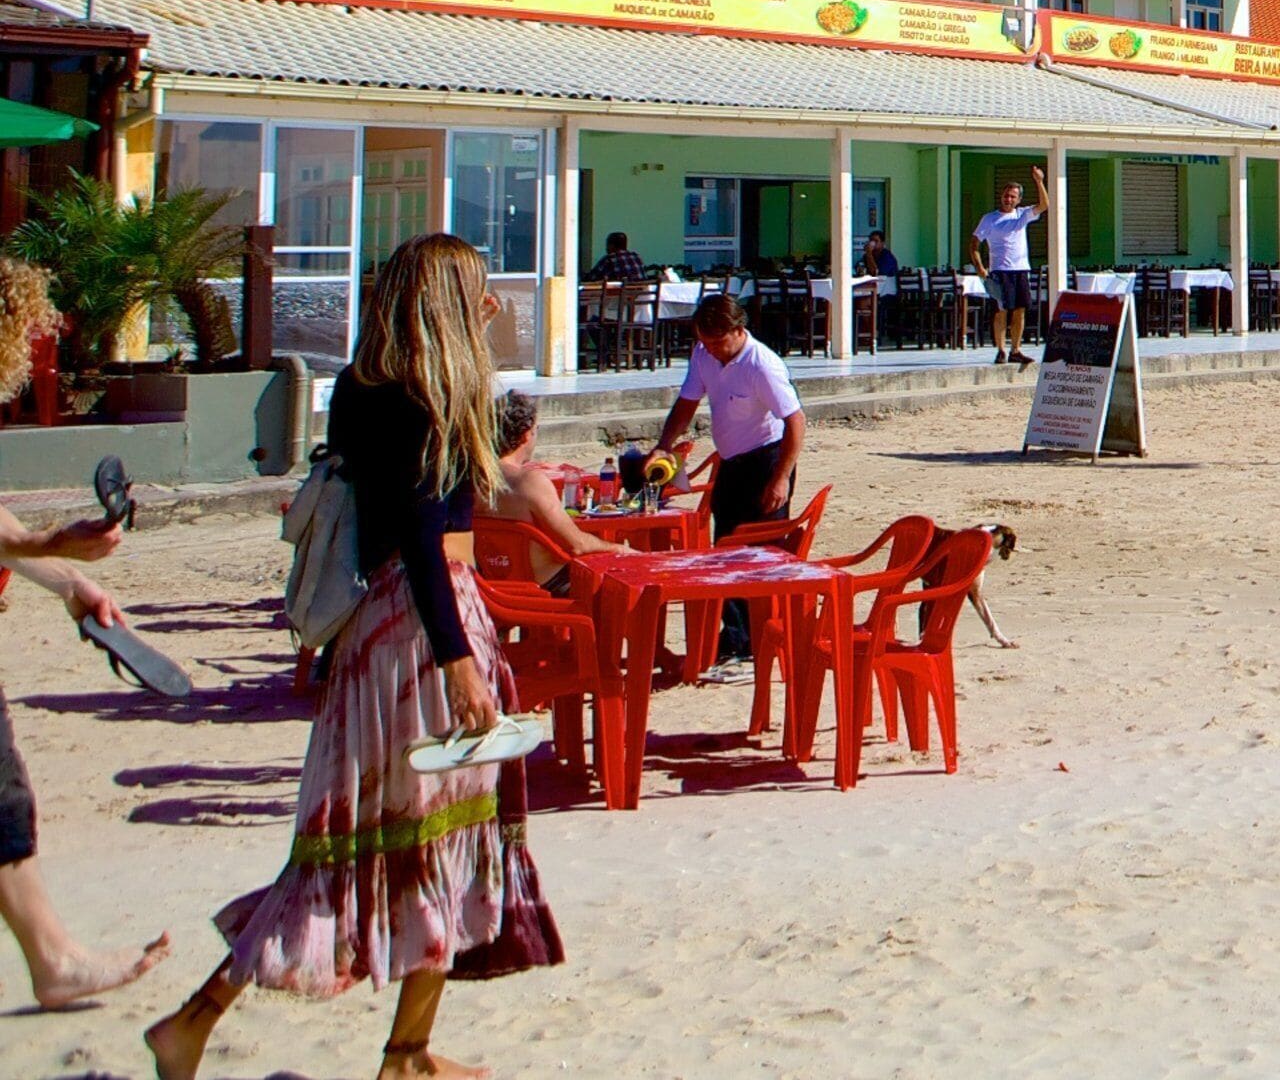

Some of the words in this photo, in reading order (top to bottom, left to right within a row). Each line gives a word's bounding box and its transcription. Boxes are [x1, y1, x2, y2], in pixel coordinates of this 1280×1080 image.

[614, 3, 657, 16] MUQUECA
[658, 9, 667, 17] DE
[668, 7, 715, 21] CAMARÃO
[899, 6, 936, 19] CAMARÃO
[937, 11, 977, 23] GRATINADO
[899, 19, 937, 31] CAMARÃO
[943, 24, 967, 34] GREGA
[899, 30, 925, 41] RISOTO
[933, 33, 970, 45] CAMARÃO
[1150, 35, 1175, 46] FRANGO
[1150, 49, 1175, 61] FRANGO
[1234, 58, 1261, 75] BEIRA
